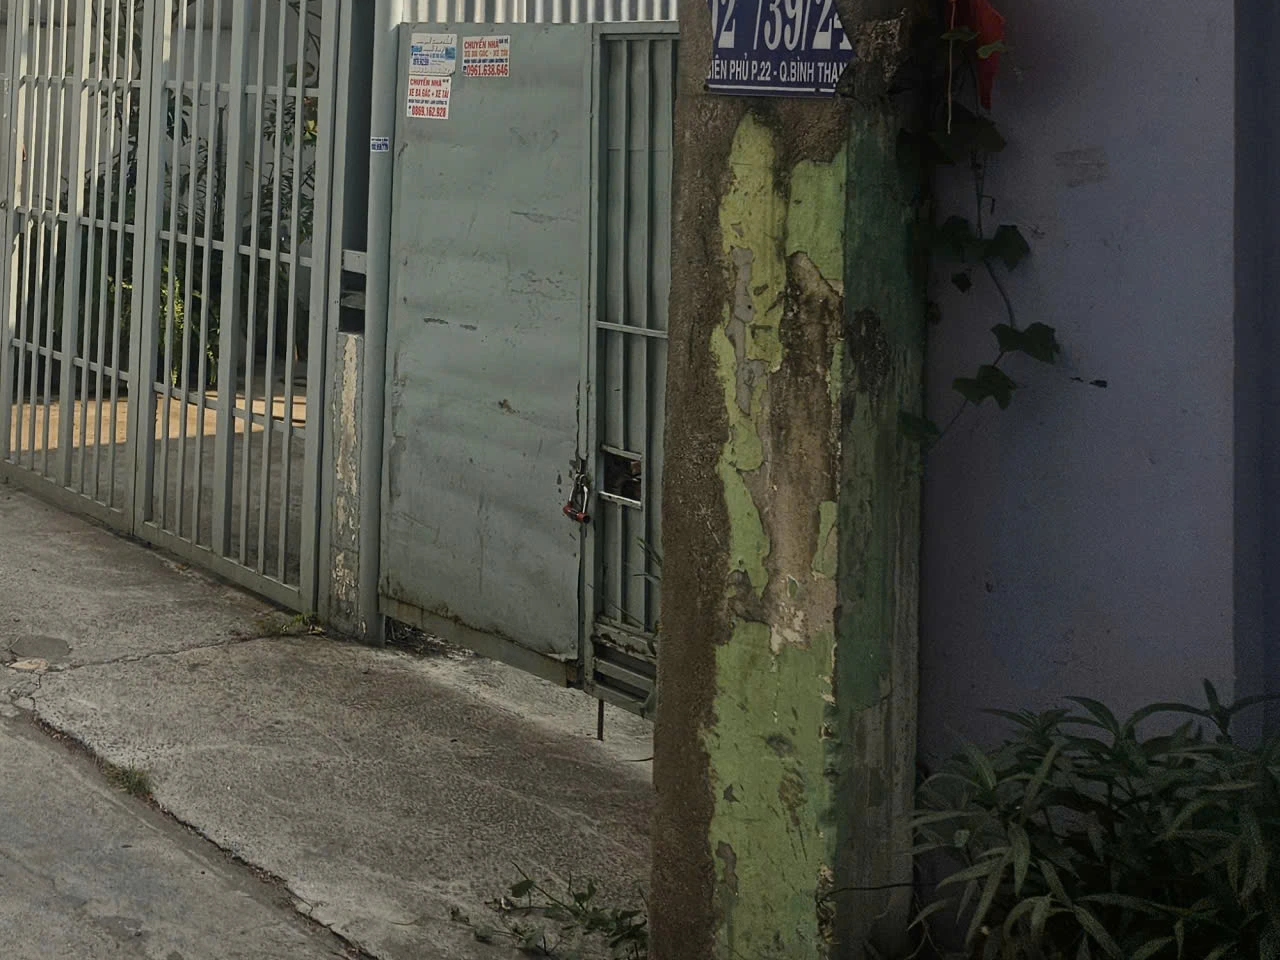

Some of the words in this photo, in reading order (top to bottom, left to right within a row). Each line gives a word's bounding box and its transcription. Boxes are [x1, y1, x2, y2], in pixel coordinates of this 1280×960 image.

[706, 54, 727, 80] IÊN
[730, 52, 748, 80] PHỦ
[751, 60, 771, 80] P.22
[780, 56, 814, 82] Q.BÌNH
